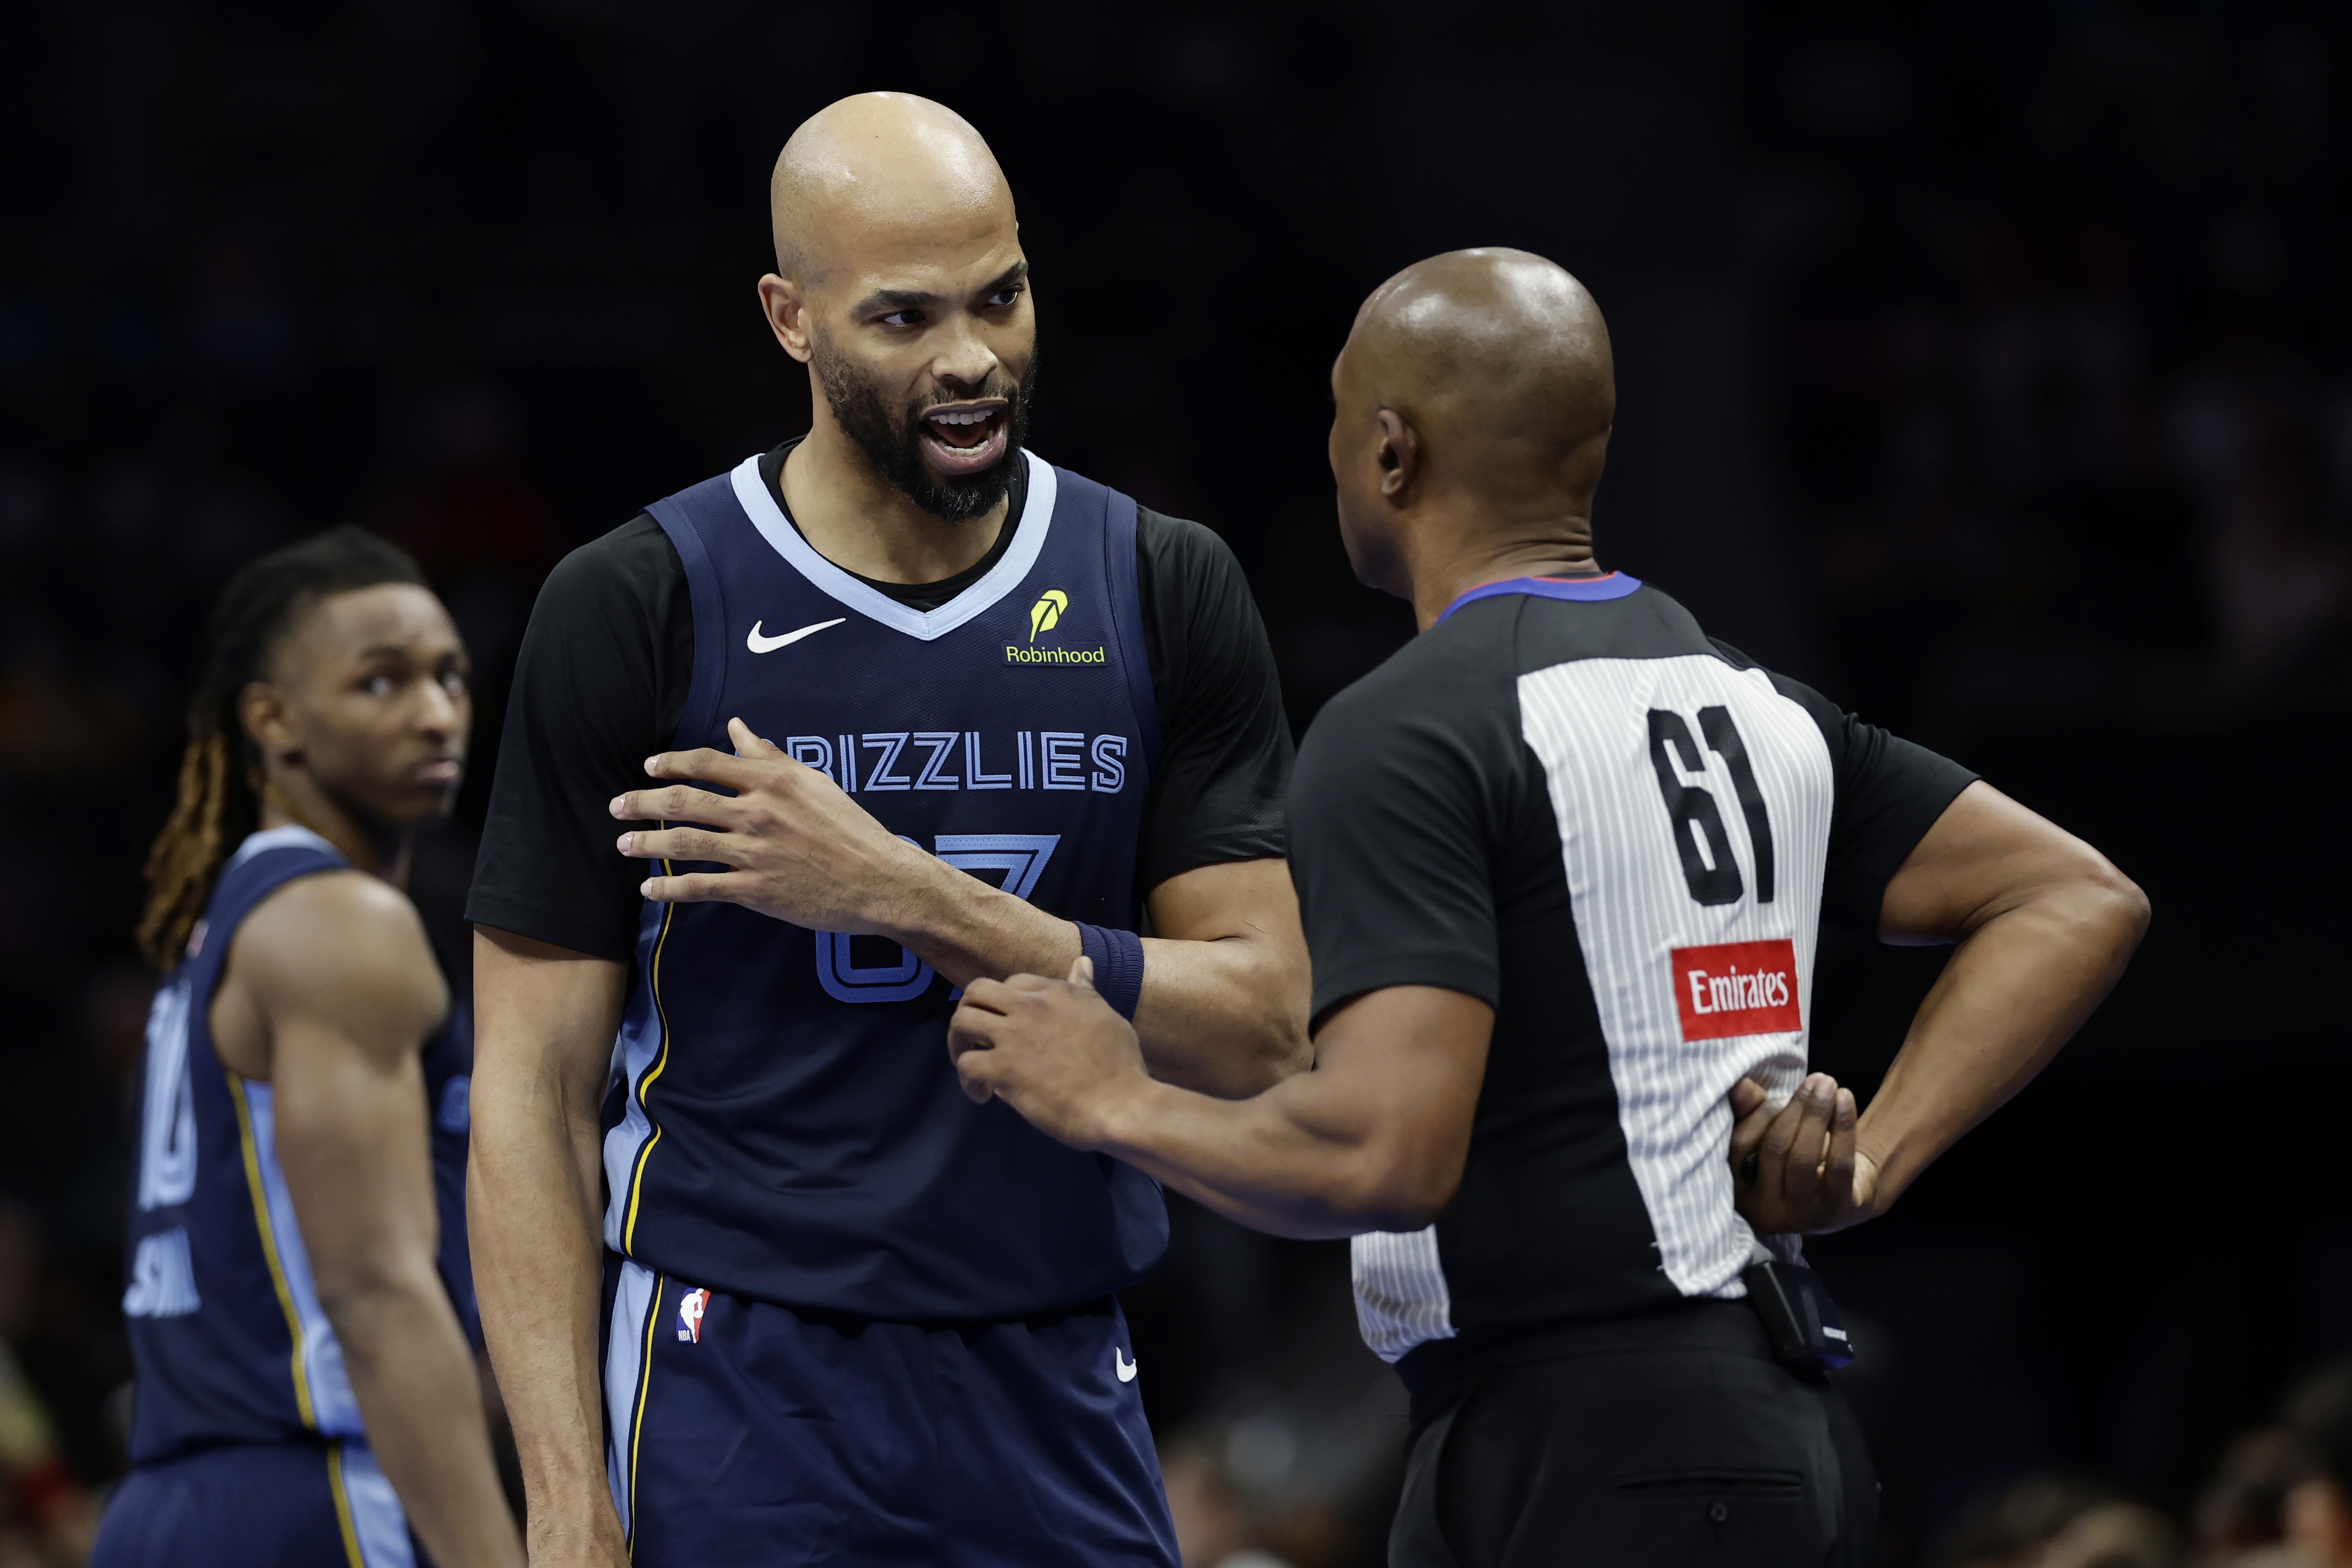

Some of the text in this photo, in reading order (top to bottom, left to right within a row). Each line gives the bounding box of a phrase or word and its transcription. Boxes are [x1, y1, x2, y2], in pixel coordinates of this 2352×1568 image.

[1006, 646, 1105, 663] Robinhood
[735, 731, 1128, 794] RIZZLIES
[1647, 705, 1775, 907] 61
[1688, 966, 1790, 1015] Emirates
[678, 1330, 691, 1341] NBA
